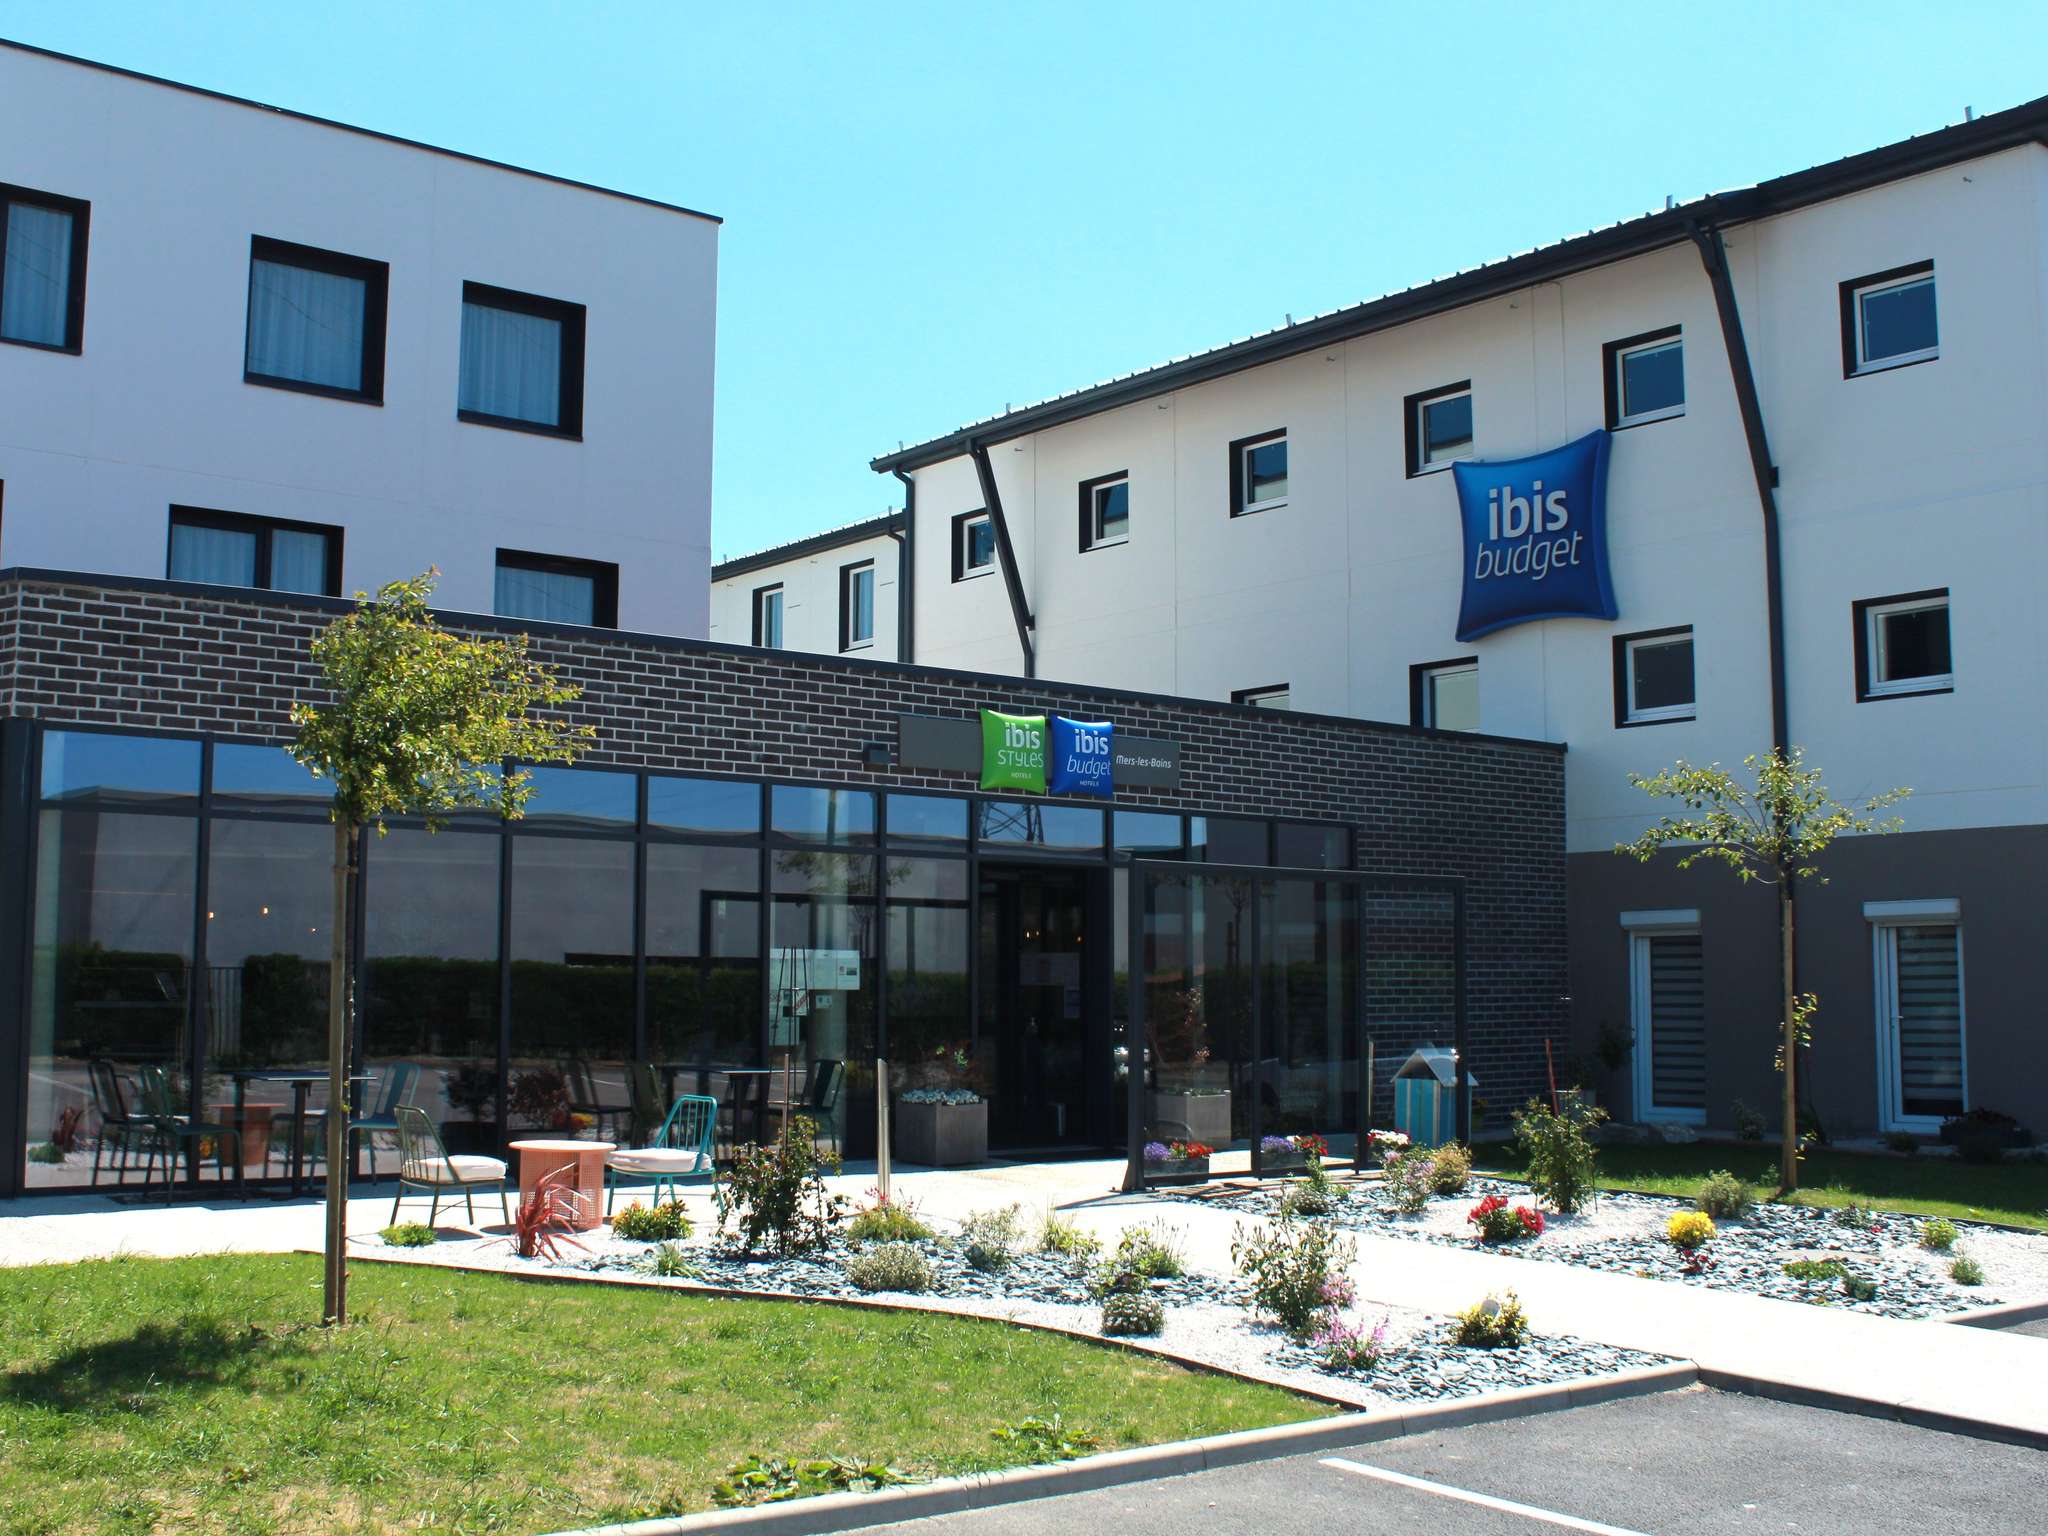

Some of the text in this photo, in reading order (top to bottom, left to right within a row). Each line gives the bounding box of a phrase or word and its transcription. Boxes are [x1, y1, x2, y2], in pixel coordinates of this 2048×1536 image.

[1488, 480, 1569, 541] ibis
[1474, 530, 1584, 581] budget
[1004, 721, 1041, 750] ibis
[1074, 728, 1109, 756] ibis
[1066, 754, 1112, 779] budget
